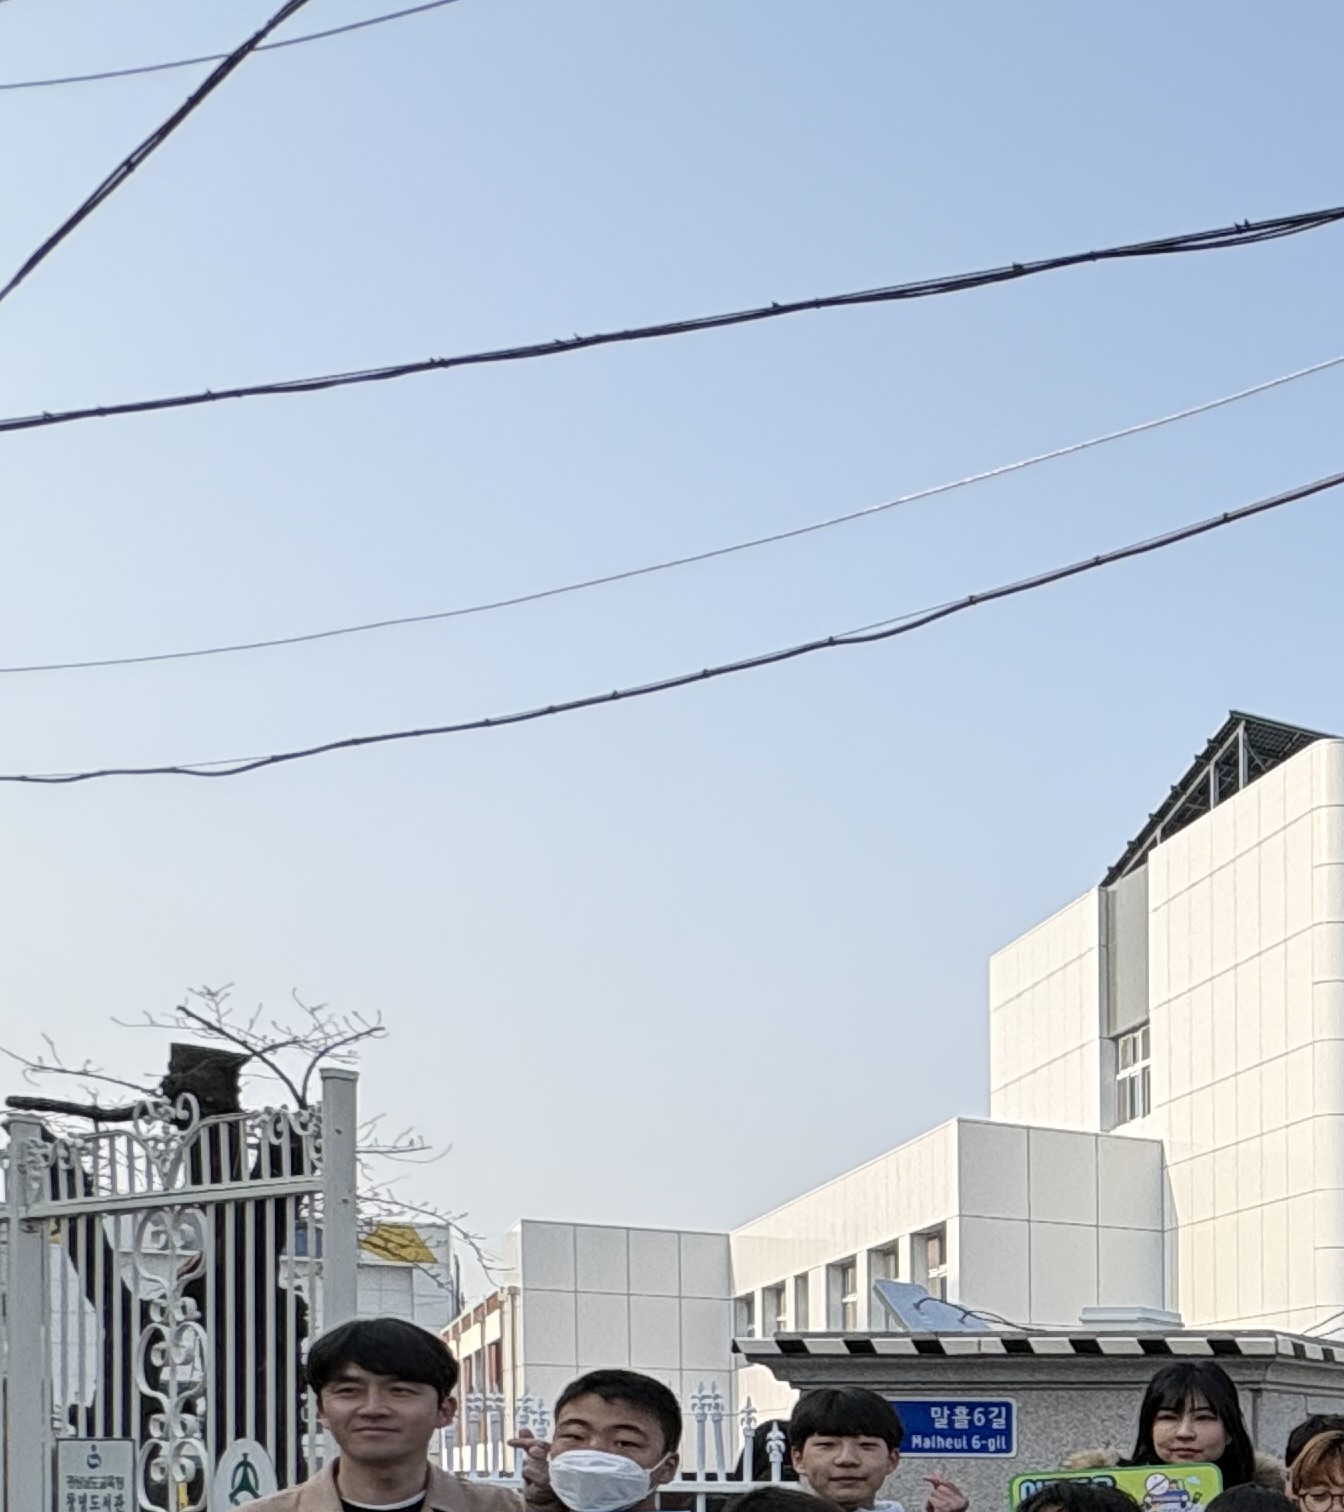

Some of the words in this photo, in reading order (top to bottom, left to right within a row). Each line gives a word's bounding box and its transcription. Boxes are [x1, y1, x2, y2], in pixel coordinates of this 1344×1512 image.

[930, 1405, 1007, 1430] 말흘6길
[911, 1434, 968, 1450] Malheul
[971, 1435, 1007, 1452] 6-gil
